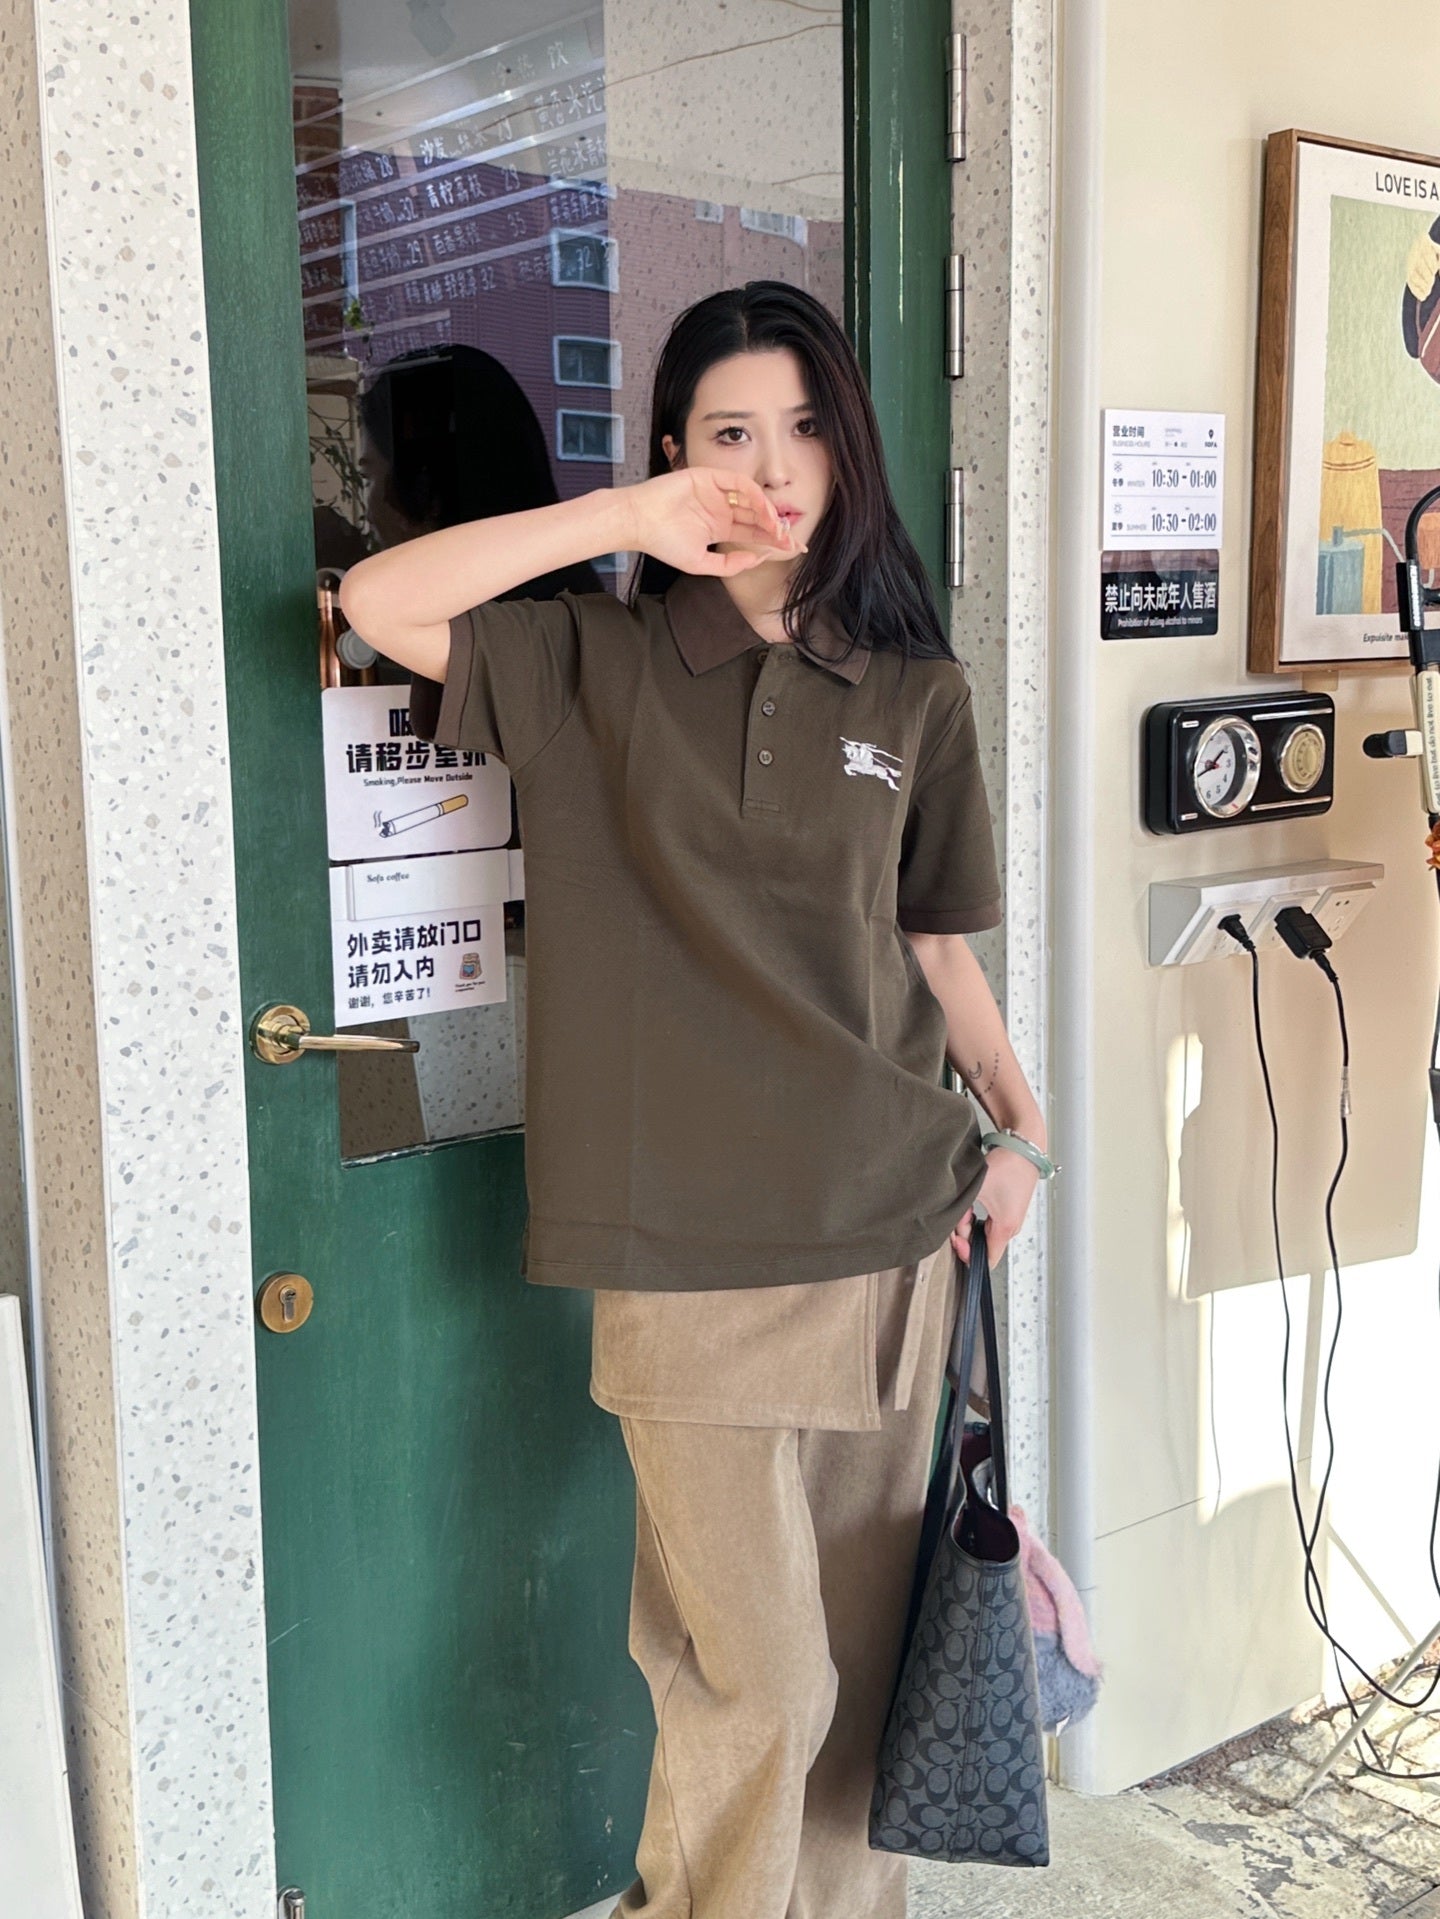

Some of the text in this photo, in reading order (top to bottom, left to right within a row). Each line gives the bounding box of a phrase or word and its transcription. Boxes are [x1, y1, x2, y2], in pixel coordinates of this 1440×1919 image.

[1375, 171, 1440, 201] LOVE IS A
[1112, 425, 1145, 438] 营业时间
[1152, 469, 1179, 488] 10:30
[1190, 470, 1217, 489] 01:00
[1151, 513, 1179, 532] 10:30
[1188, 513, 1217, 532] 02:00
[1105, 582, 1217, 613] 禁止向未成年人售酒
[424, 775, 443, 783] Move
[446, 773, 473, 782] Outside
[367, 872, 410, 884] Sofa coffee
[347, 919, 482, 959] 外卖请放门口
[348, 956, 434, 989] 请勿入内
